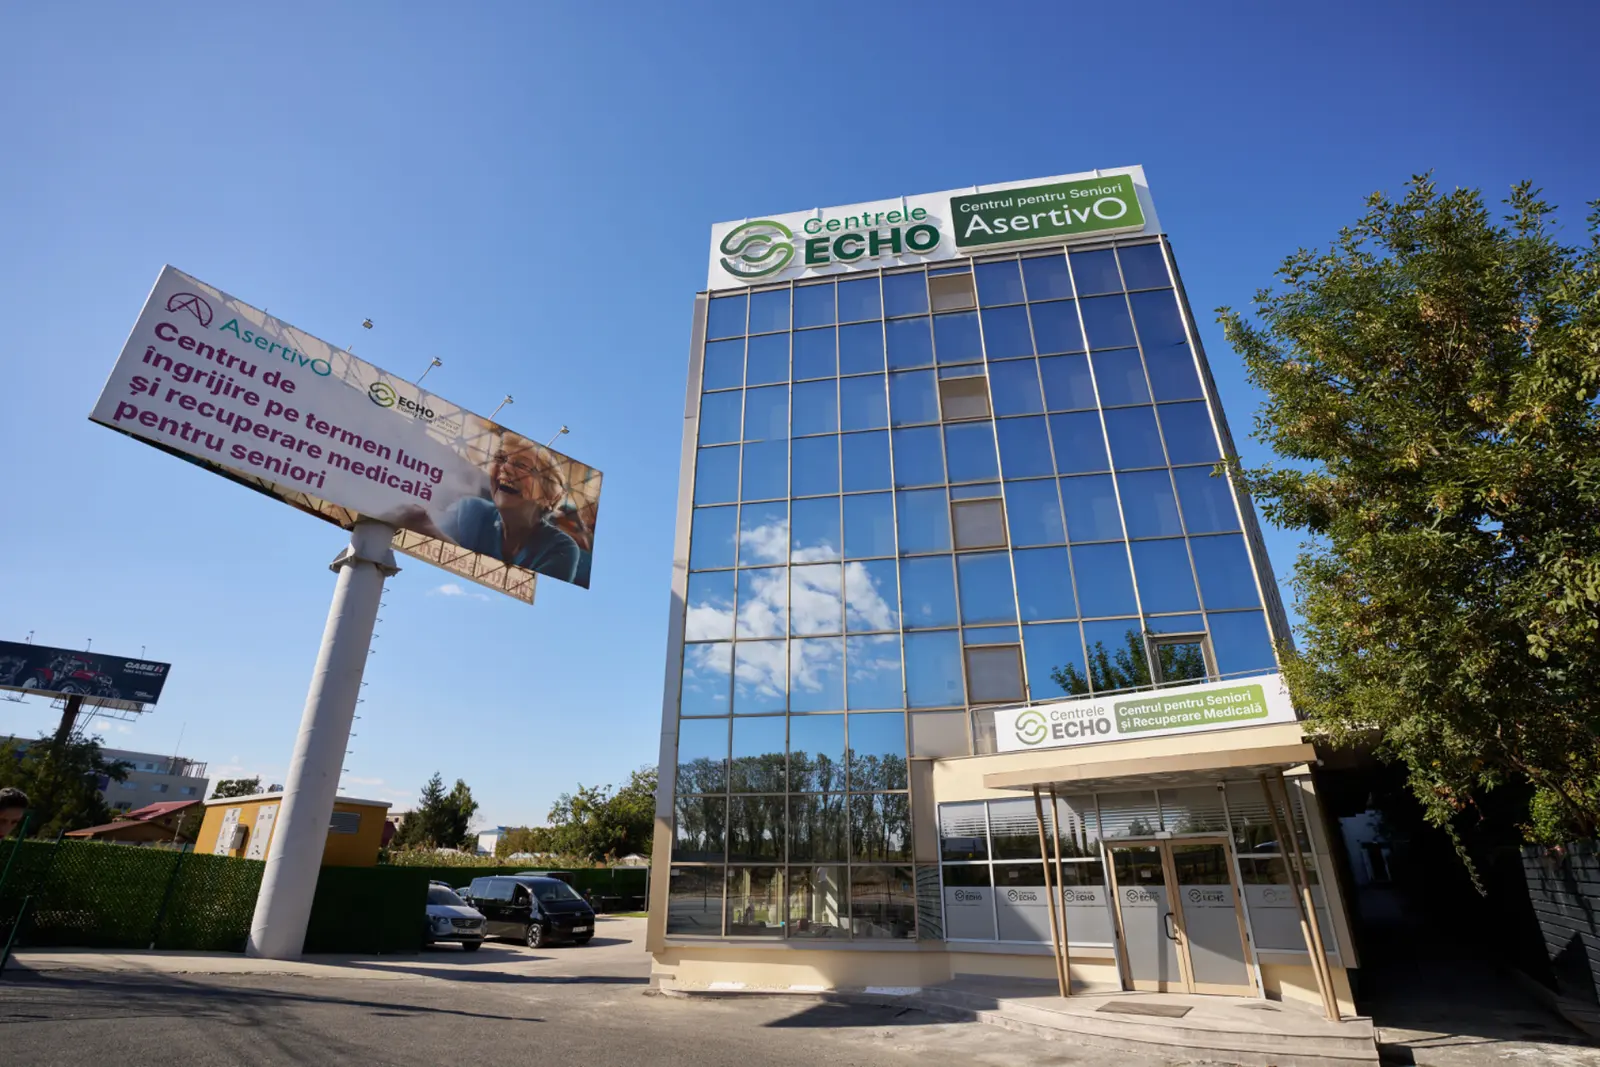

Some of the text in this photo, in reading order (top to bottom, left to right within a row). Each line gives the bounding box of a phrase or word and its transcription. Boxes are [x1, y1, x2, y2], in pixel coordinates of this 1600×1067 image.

[960, 183, 1123, 213] Centrul pentru Seniori
[803, 206, 927, 235] Centrele
[964, 196, 1127, 238] AsertivO
[804, 224, 940, 268] ECHO
[154, 322, 296, 394] Centru de
[219, 318, 332, 376] AsertivO
[142, 346, 260, 407] îngrijire
[264, 399, 300, 422] pe
[305, 412, 392, 461] termen
[396, 448, 444, 484] lung
[398, 396, 434, 418] ECHO
[112, 400, 327, 489] pentru seniori
[129, 374, 433, 501] și recuperare medicală
[125, 661, 155, 671] CASE
[1050, 705, 1105, 721] Centrele
[1119, 690, 1252, 717] Centrul pentru Seniori
[1120, 703, 1263, 732] și Recuperare Medicală
[1052, 718, 1111, 740] ECHO
